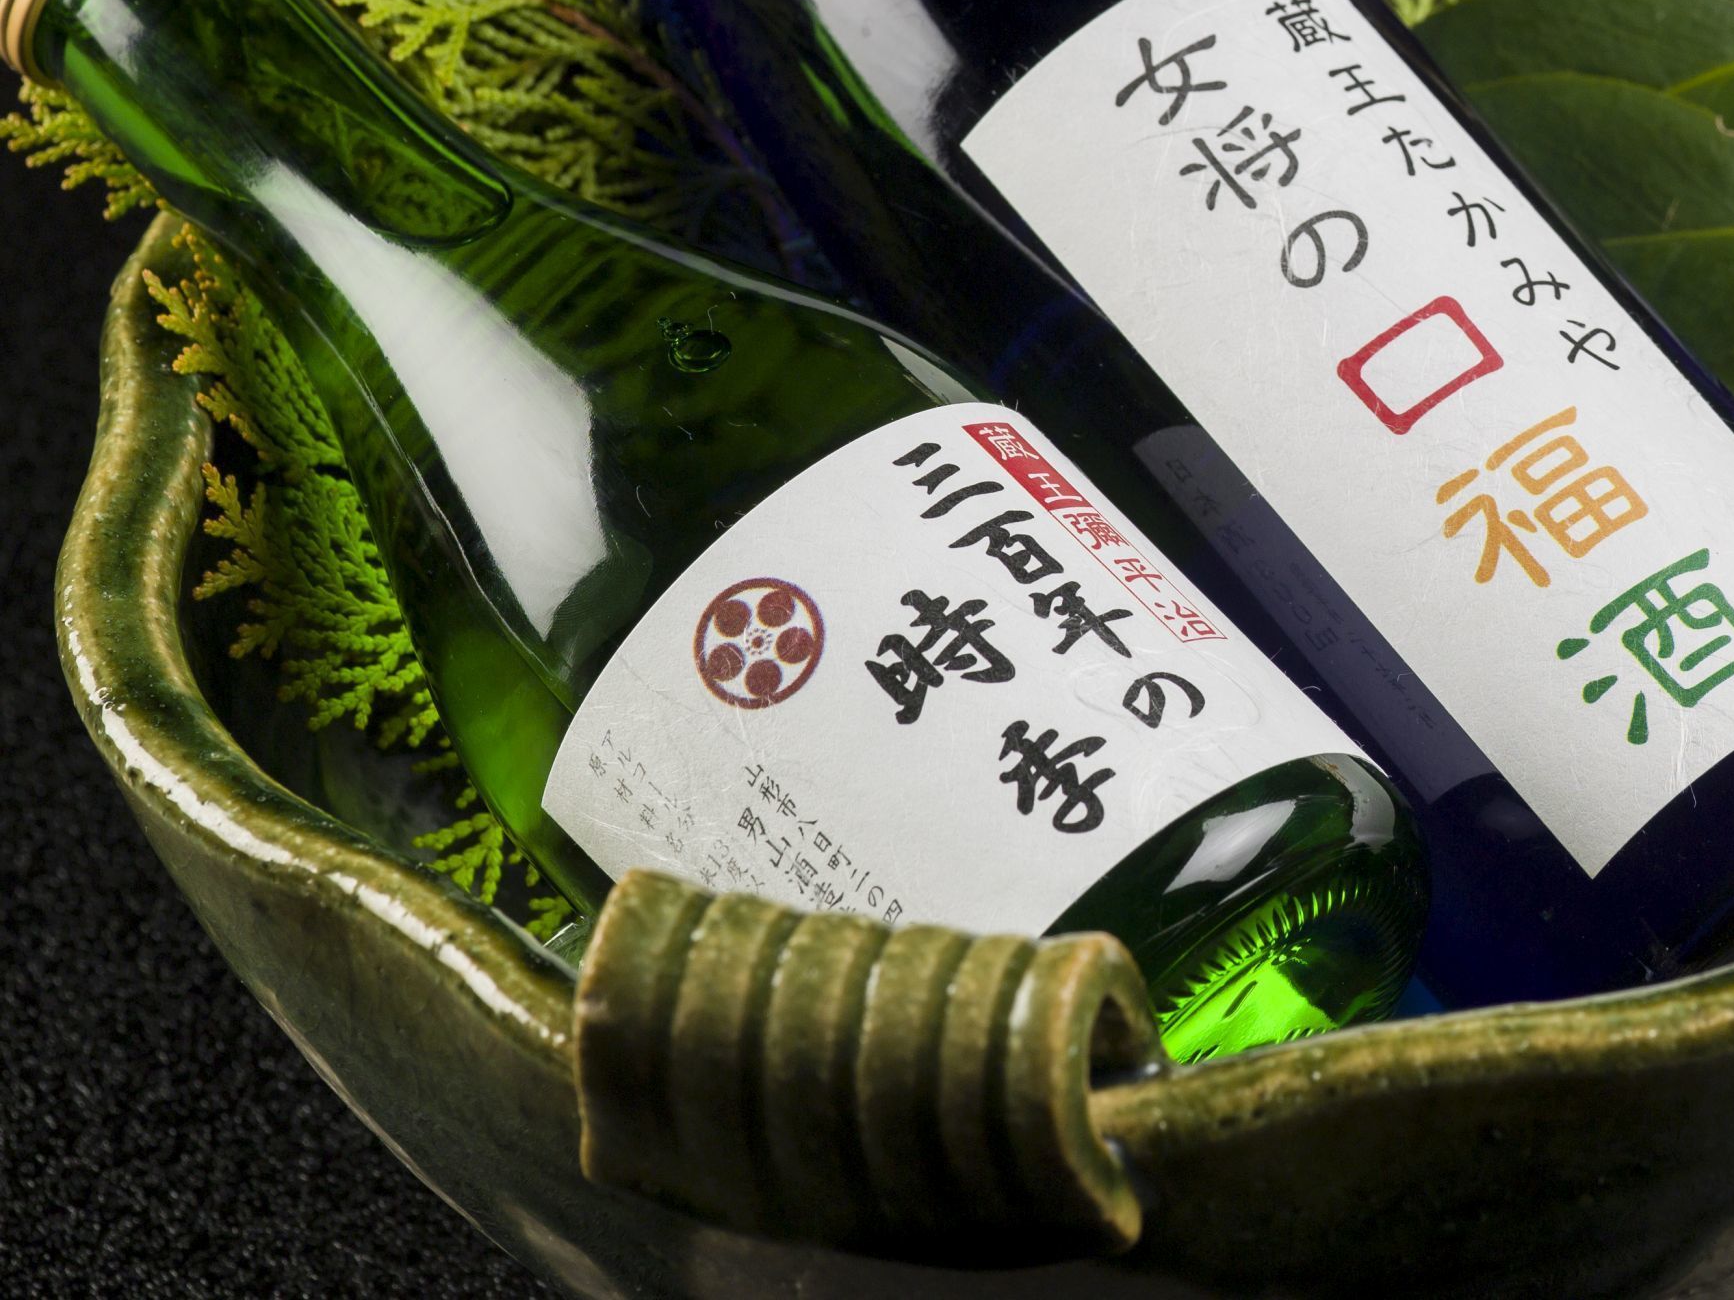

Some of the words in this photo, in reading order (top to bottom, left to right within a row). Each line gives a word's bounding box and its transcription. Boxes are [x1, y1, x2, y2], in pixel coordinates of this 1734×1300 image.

[892, 442, 1206, 729] 三百年の
[737, 806, 857, 912] 男山酒造
